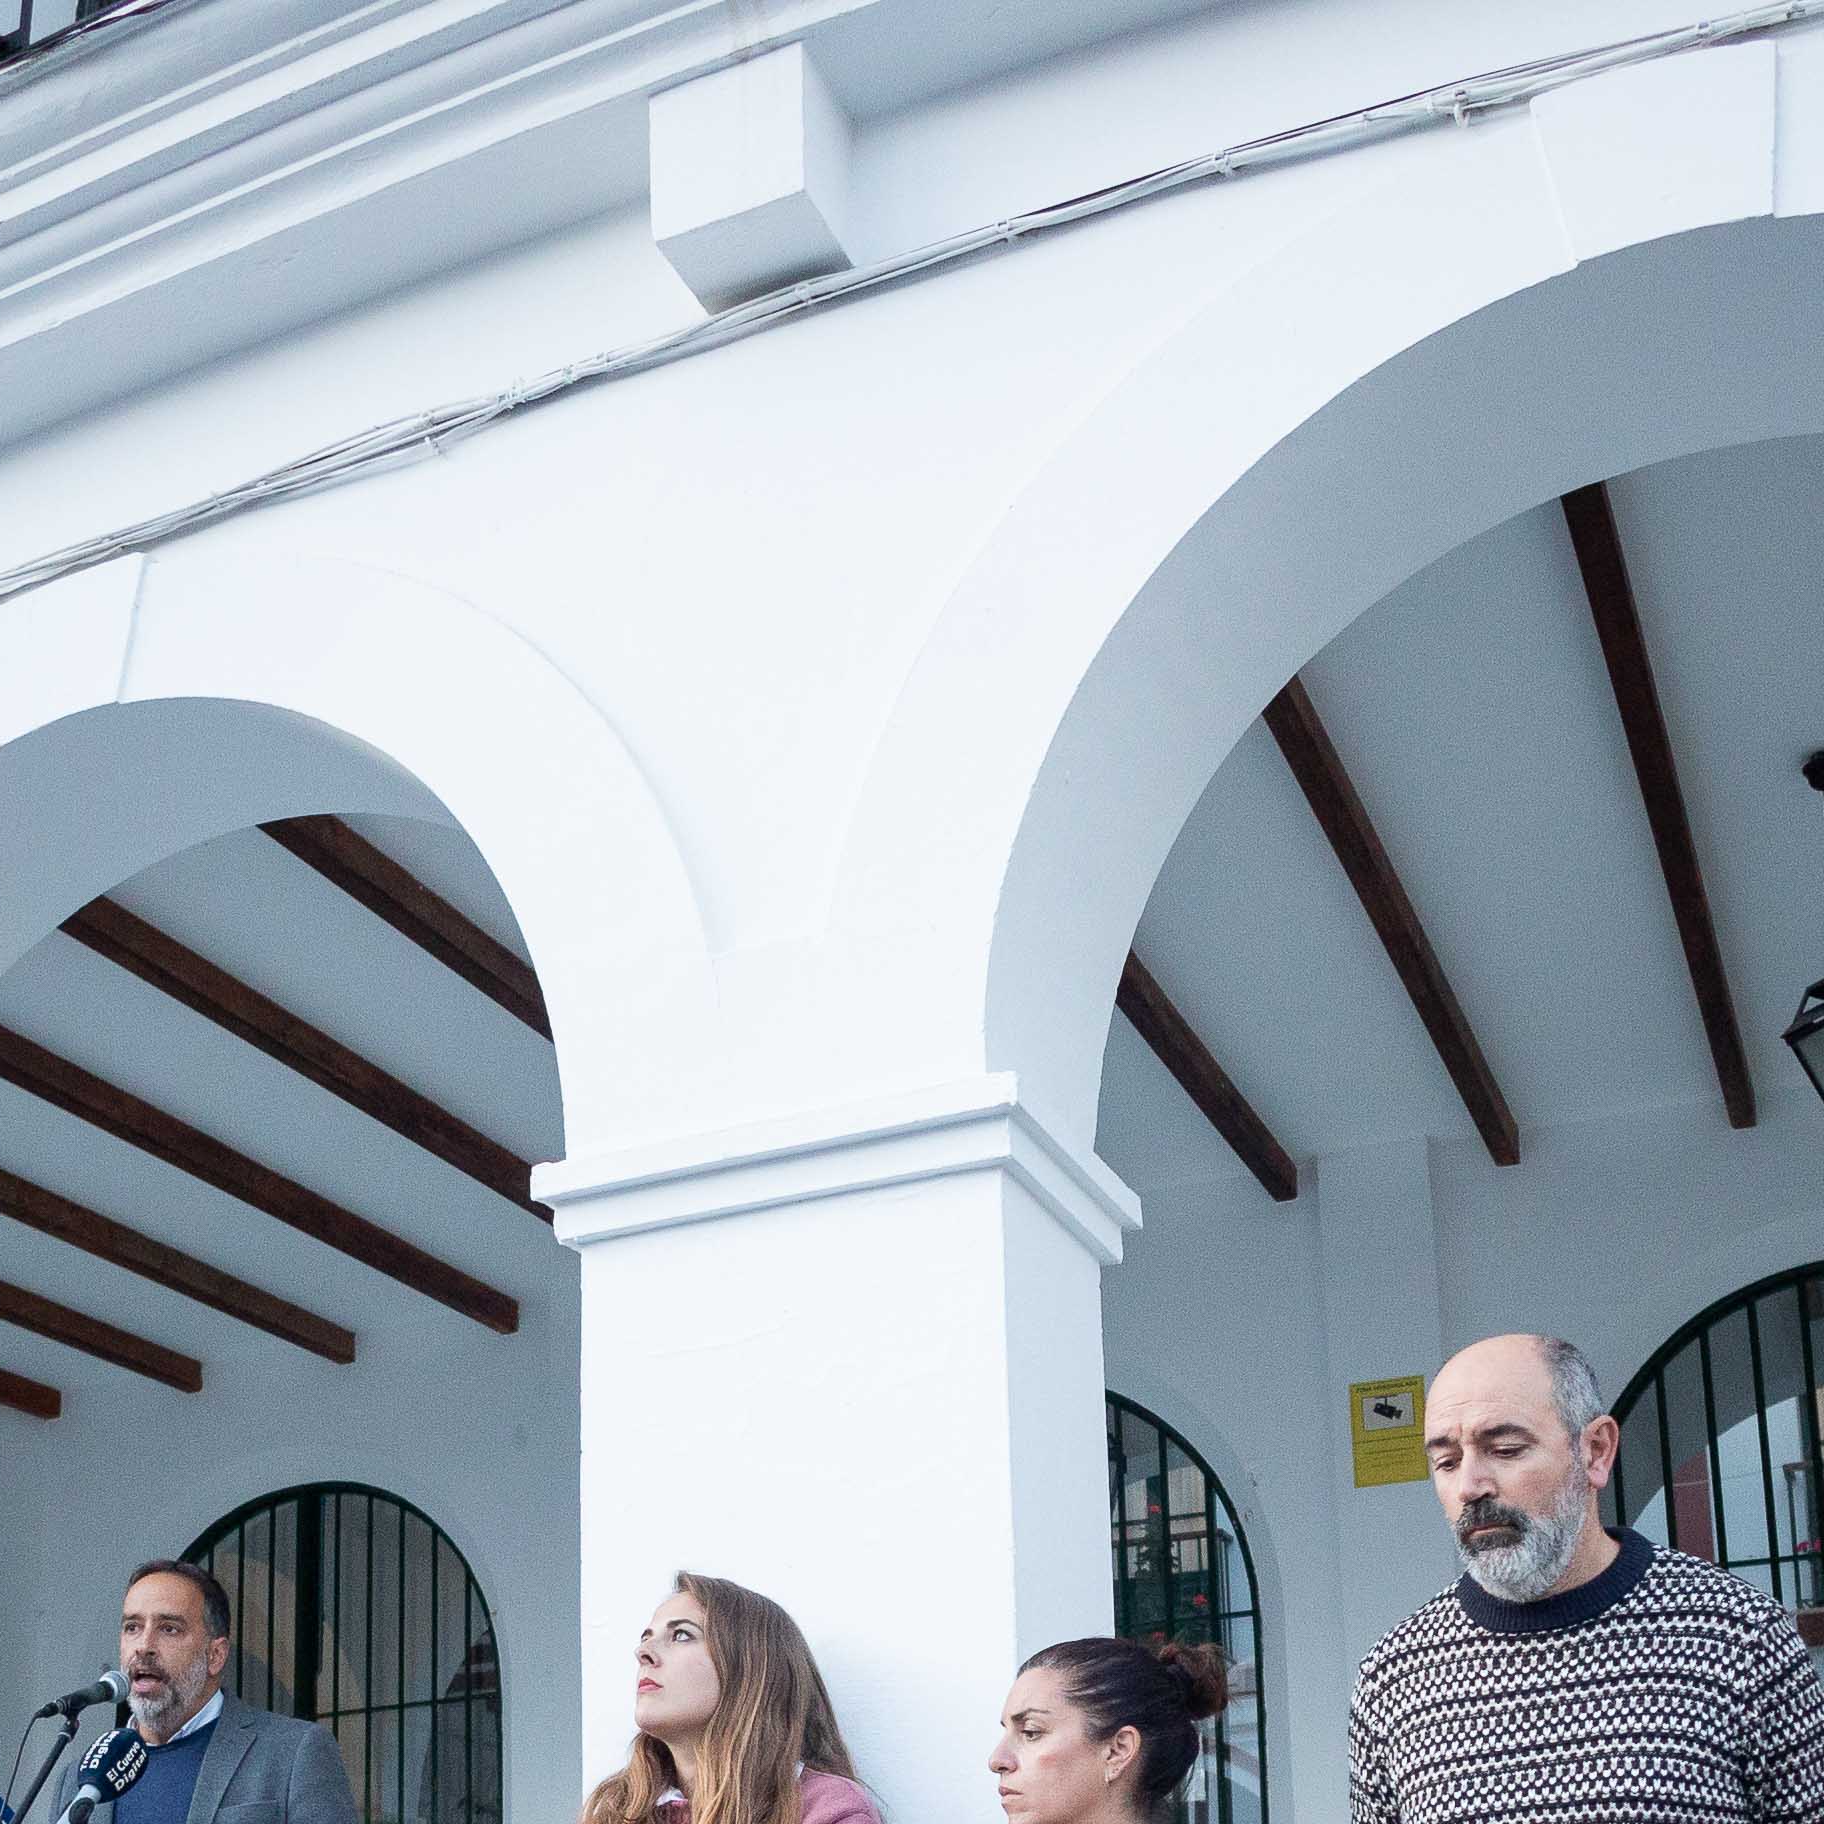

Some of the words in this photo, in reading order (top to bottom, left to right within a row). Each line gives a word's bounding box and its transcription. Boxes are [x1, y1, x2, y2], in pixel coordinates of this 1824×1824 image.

[106, 1768, 118, 1782] El
[116, 1741, 141, 1771] Cuervo
[114, 1748, 147, 1792] Digital
